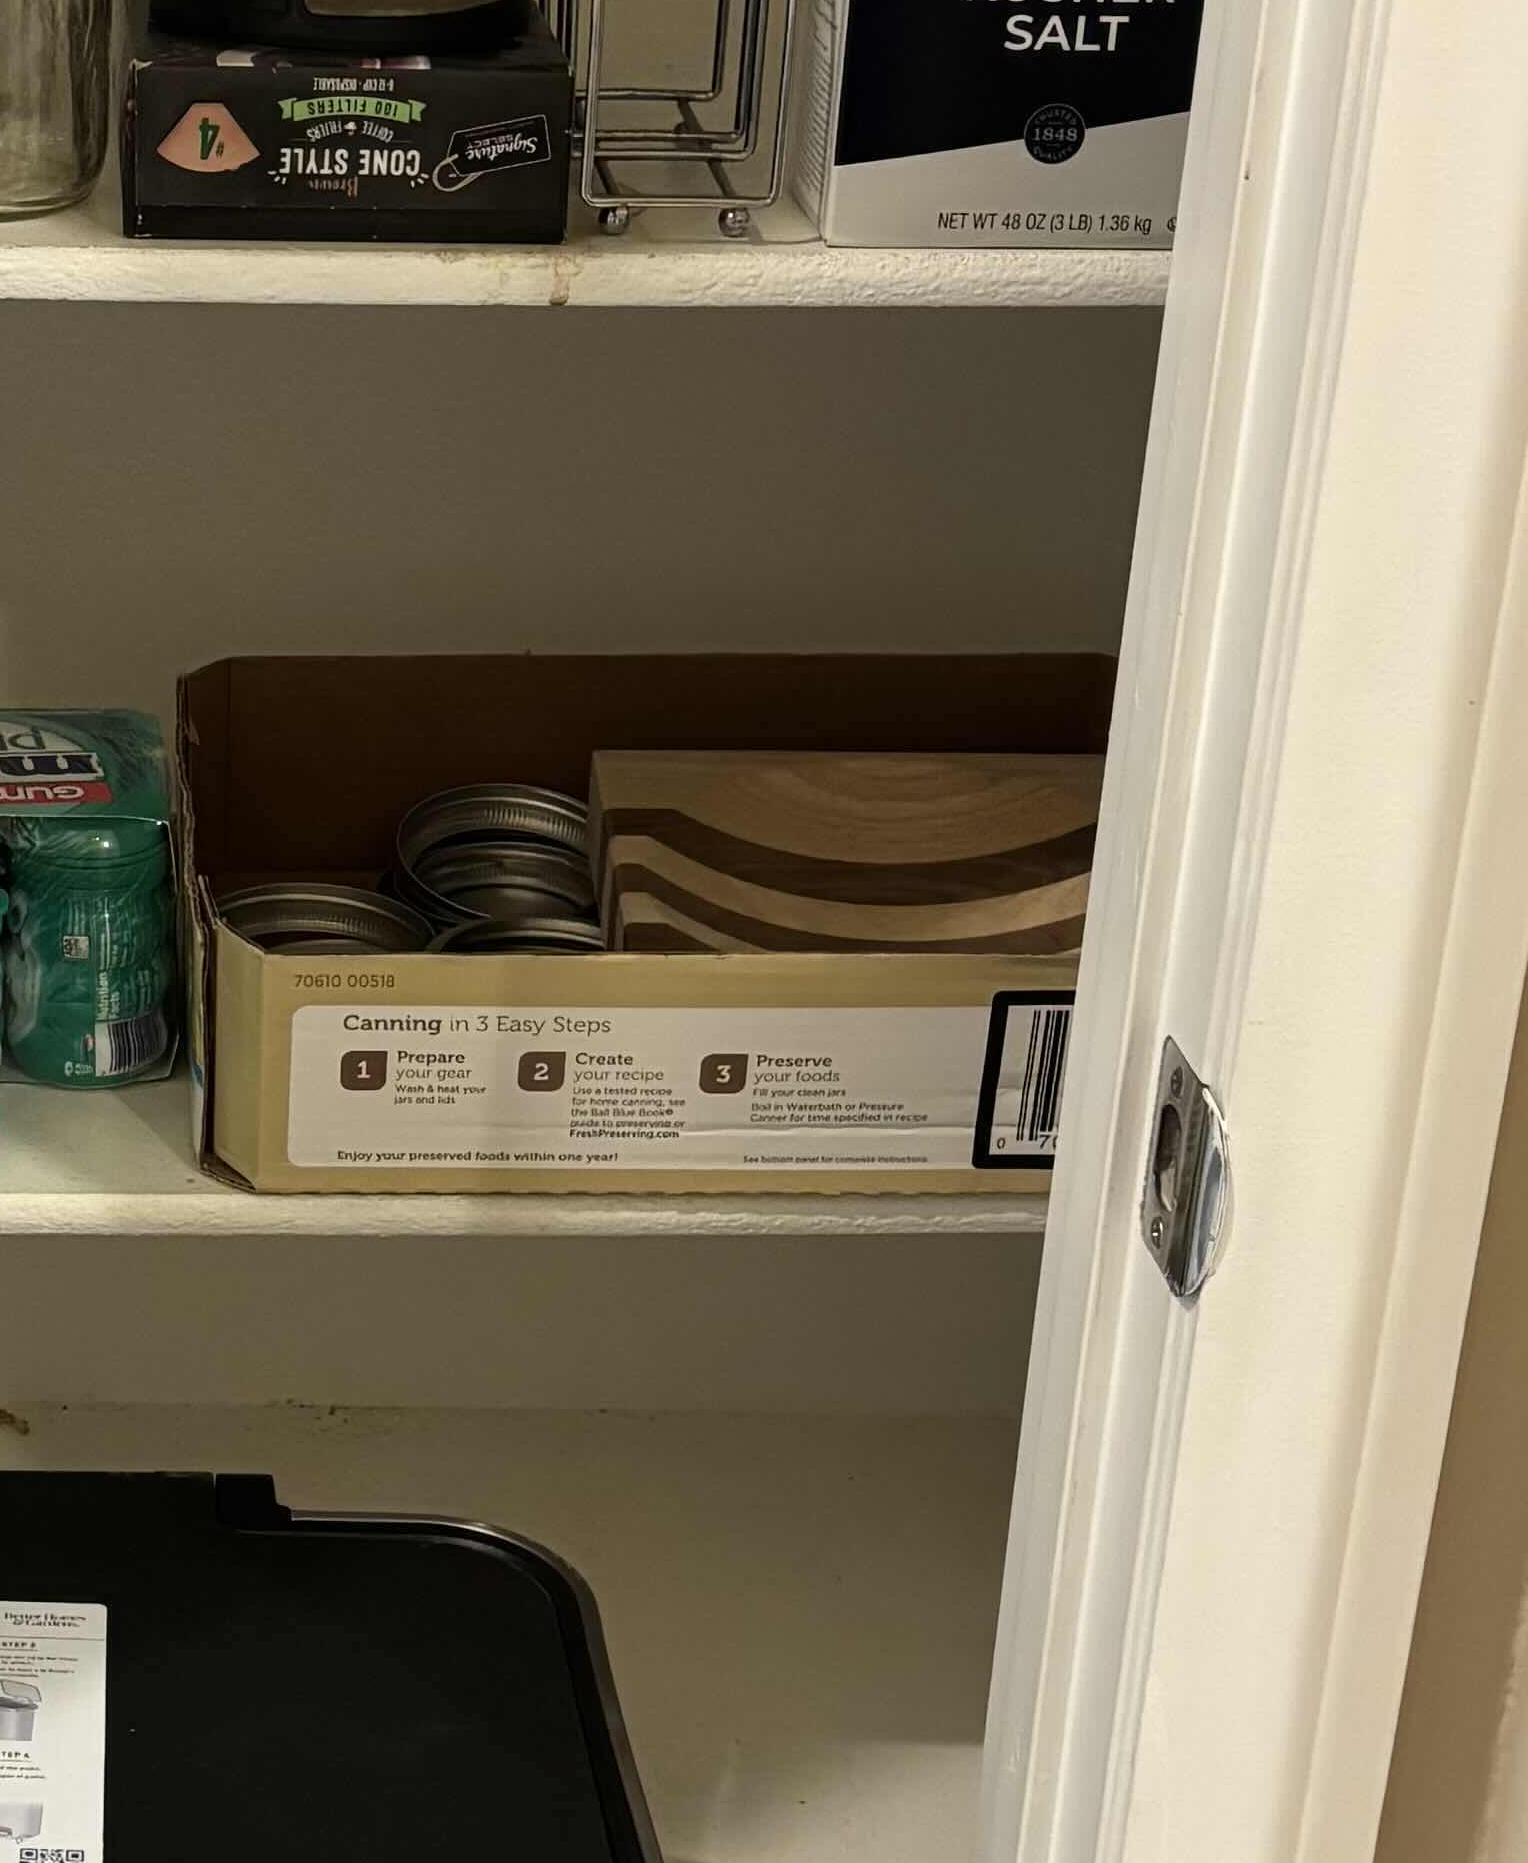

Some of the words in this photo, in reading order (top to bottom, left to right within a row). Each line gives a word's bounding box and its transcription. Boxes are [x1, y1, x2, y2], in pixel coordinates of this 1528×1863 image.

[1003, 14, 1131, 51] SALT
[305, 99, 368, 116] FILTERS
[370, 100, 401, 118] 100
[304, 120, 344, 143] FILTERS
[359, 120, 395, 144] COFFEE
[1032, 126, 1078, 143] 1848
[462, 133, 539, 164] Signature
[279, 146, 350, 176] STYLE
[358, 147, 422, 178] CONE
[307, 175, 360, 198] Brown
[937, 212, 970, 230] NET
[972, 212, 999, 230] WT
[1001, 212, 1021, 230] 48
[1025, 213, 1047, 231] OZ
[1049, 214, 1065, 234] (3
[1068, 214, 1093, 234] LB)
[1099, 215, 1130, 232] 1.36
[1134, 215, 1152, 235] kg
[294, 973, 342, 989] 70610
[347, 973, 396, 989] 00518
[342, 1014, 443, 1035] Canning
[449, 1016, 469, 1033] in
[475, 1016, 489, 1033] 3
[496, 1016, 546, 1037] Easy
[552, 1016, 612, 1037] Steps
[397, 1049, 466, 1067] Prepare
[575, 1052, 634, 1066] Create
[755, 1054, 833, 1068] Preserve
[356, 1060, 371, 1079] 1
[395, 1068, 433, 1083] your
[437, 1068, 473, 1083] gear
[533, 1063, 550, 1081] 2
[573, 1070, 611, 1084] your
[615, 1069, 665, 1084] recipe
[716, 1065, 732, 1083] 3
[753, 1070, 790, 1085] your
[794, 1069, 841, 1083] foods
[773, 1103, 784, 1111] in
[786, 1102, 843, 1112] Waterbath
[844, 1104, 857, 1112] or
[858, 1103, 905, 1112] Pressure
[750, 1113, 788, 1123] Canner
[788, 1113, 806, 1123] for
[807, 1114, 832, 1123] time
[833, 1113, 881, 1124] specified
[882, 1114, 894, 1122] in
[895, 1114, 929, 1124] recipe
[337, 1150, 374, 1162] Enjoy
[375, 1151, 407, 1163] your
[408, 1150, 472, 1163] preserved
[474, 1150, 511, 1162] foods
[513, 1151, 556, 1162] within
[557, 1153, 584, 1162] one
[585, 1151, 619, 1163] year!
